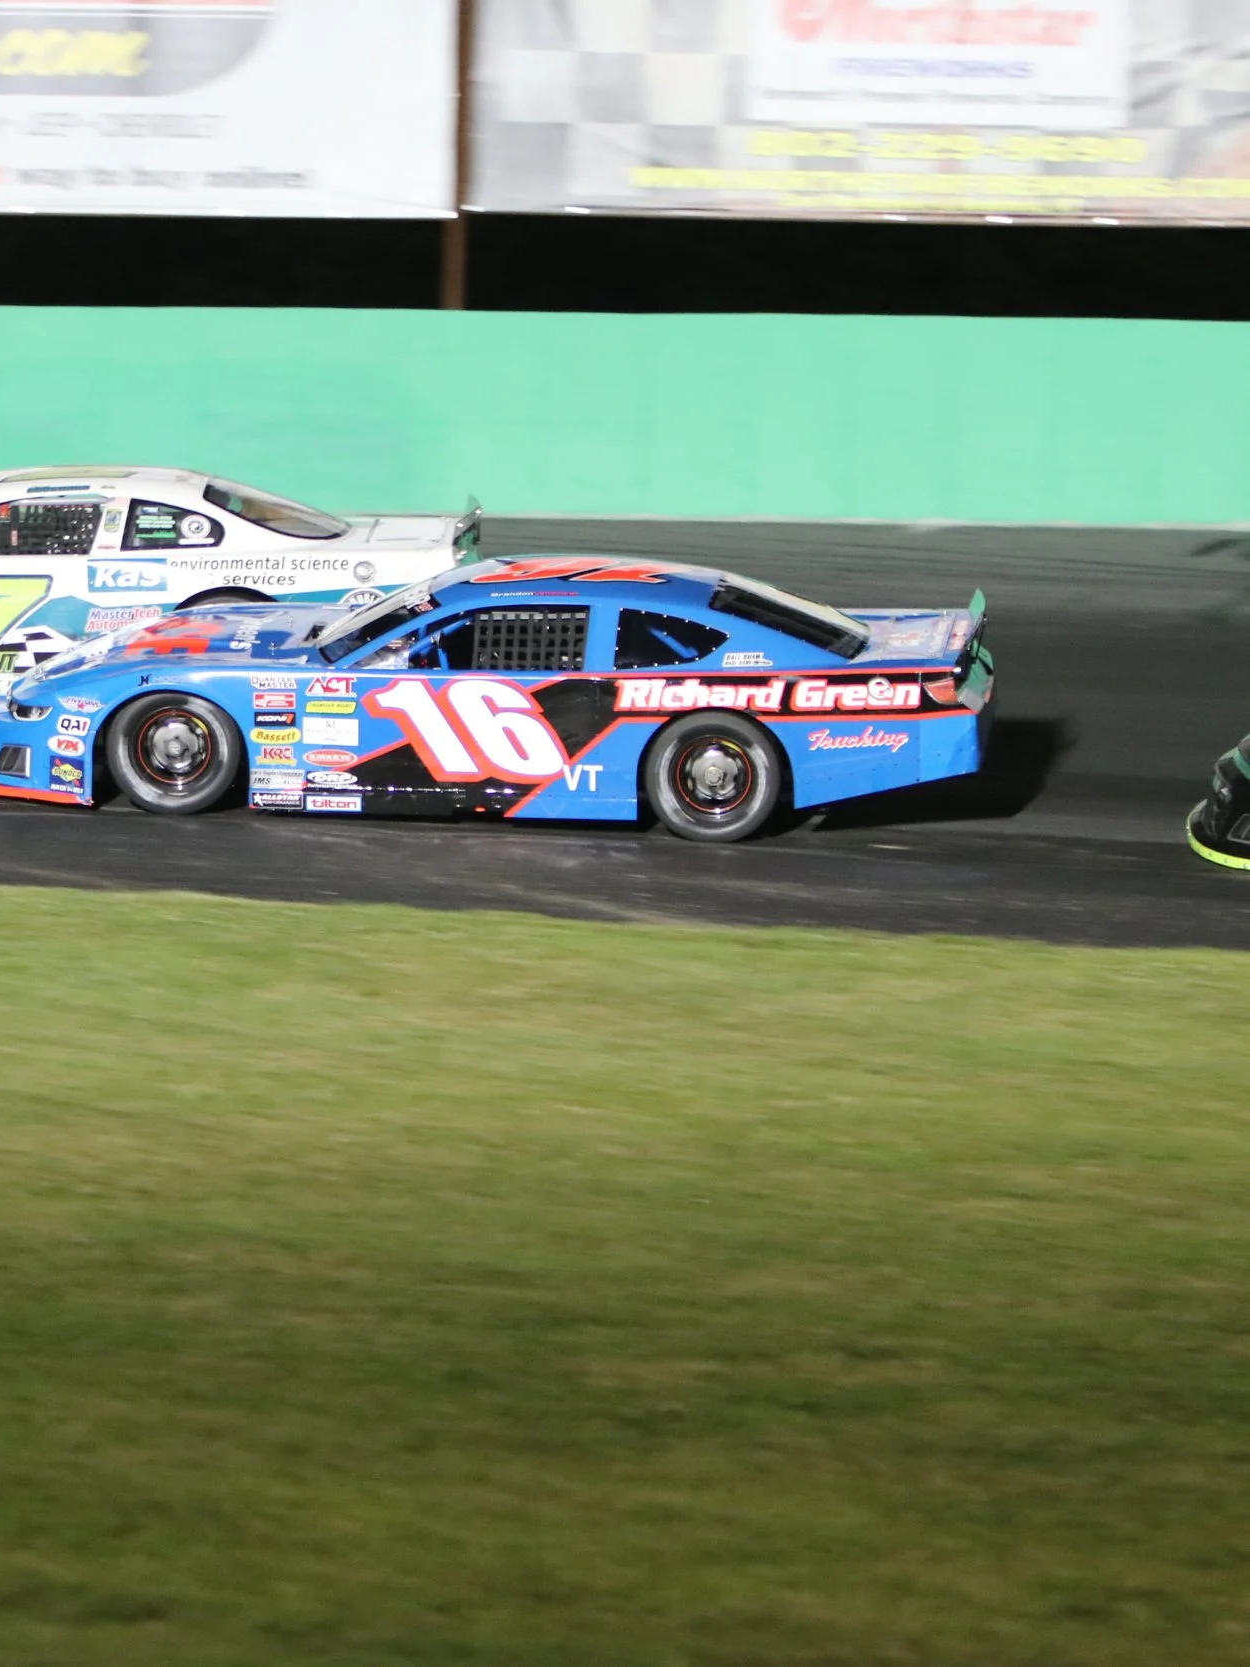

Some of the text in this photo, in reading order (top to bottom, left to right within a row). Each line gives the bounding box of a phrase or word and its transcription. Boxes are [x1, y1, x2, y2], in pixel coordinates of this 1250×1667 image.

[170, 556, 349, 571] environmental science
[92, 565, 162, 588] Kas
[222, 572, 296, 586] services
[307, 676, 356, 694] ACT
[614, 678, 923, 712] Richard Green
[60, 718, 88, 731] QA1
[368, 676, 565, 780] 16
[256, 731, 296, 742] Bassett
[808, 726, 910, 753] Trucking
[53, 767, 82, 779] SUNOCO
[563, 764, 604, 792] VT
[311, 799, 357, 809] tilton
